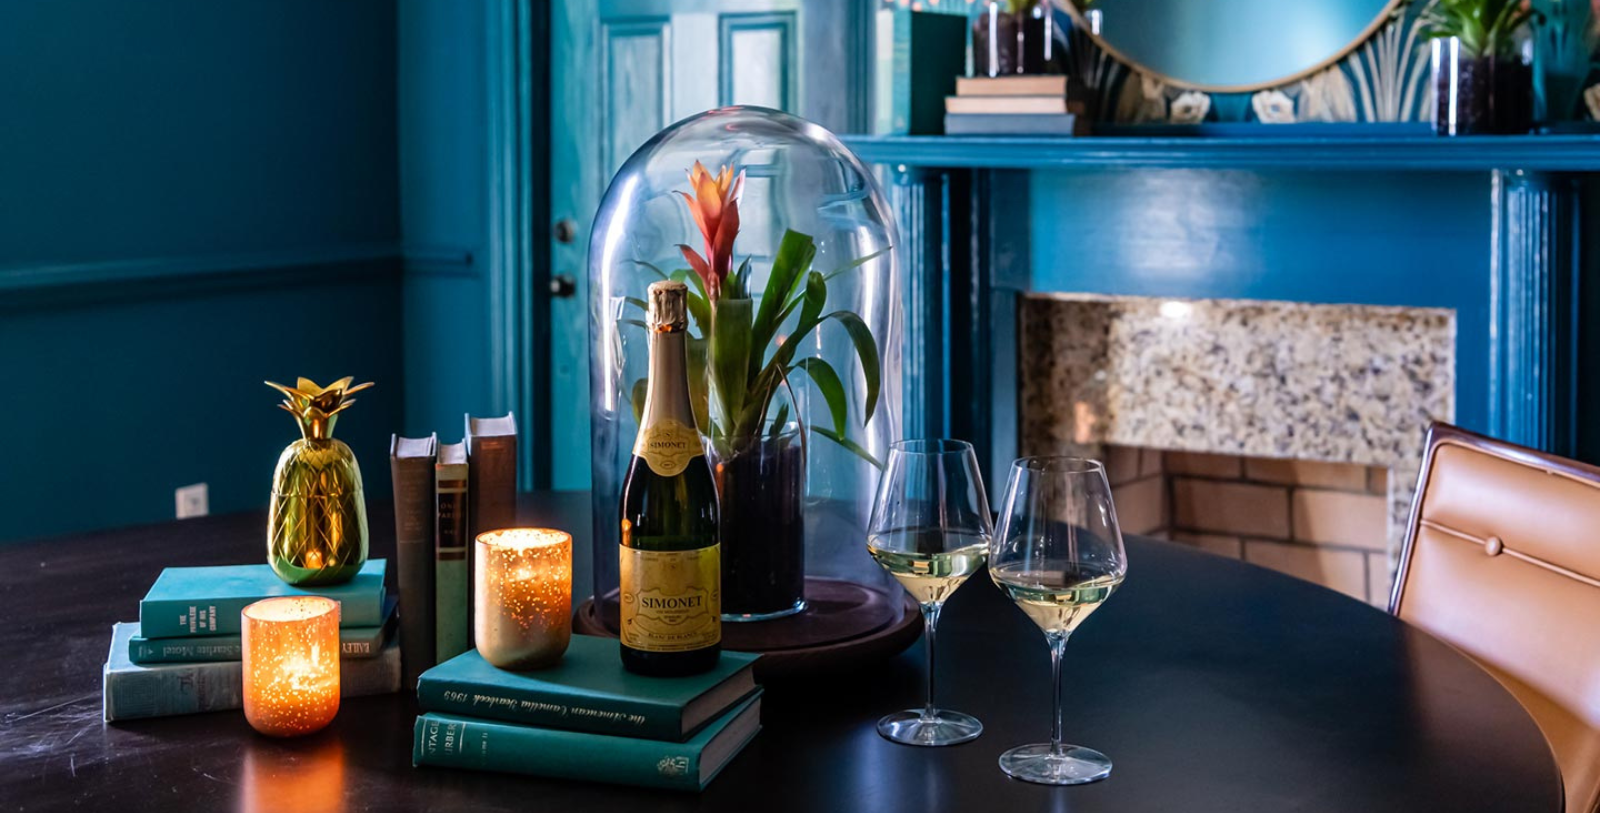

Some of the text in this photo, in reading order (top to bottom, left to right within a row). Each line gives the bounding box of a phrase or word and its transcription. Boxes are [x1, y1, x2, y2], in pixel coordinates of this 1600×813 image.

[650, 441, 686, 449] SIMONET
[641, 595, 702, 609] SIMONET
[179, 614, 187, 625] THE
[199, 609, 207, 620] HIS
[209, 605, 217, 631] COMPANY
[162, 645, 194, 658] Motel
[342, 642, 370, 654] BAILEY
[444, 690, 646, 726] the American Camellia Yearbook 1969
[428, 721, 440, 756] NTAGE
[444, 722, 457, 756] URBER
